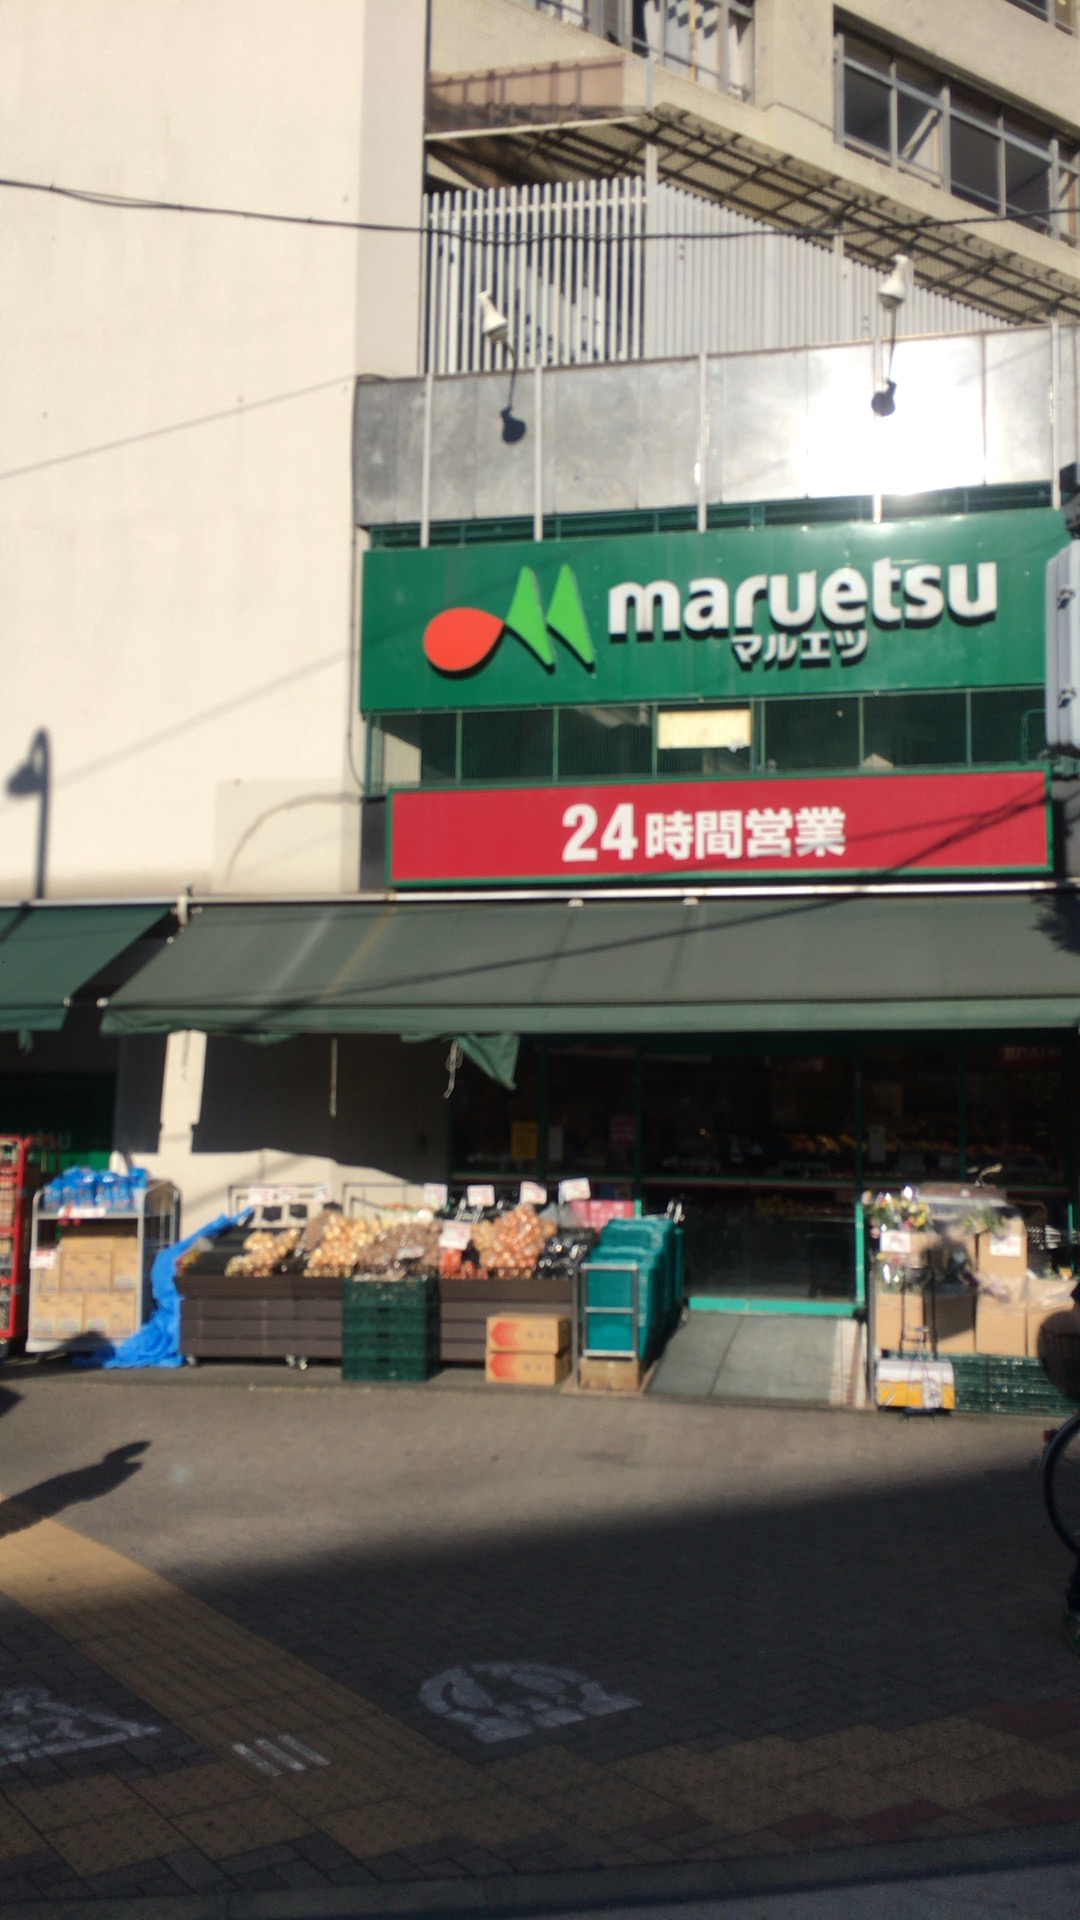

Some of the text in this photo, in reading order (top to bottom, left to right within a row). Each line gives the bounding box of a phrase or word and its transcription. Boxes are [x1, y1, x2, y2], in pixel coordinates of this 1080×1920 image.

[608, 556, 998, 637] maruetsu
[731, 629, 869, 666] マルエツ
[562, 802, 847, 863] 24時間営業
